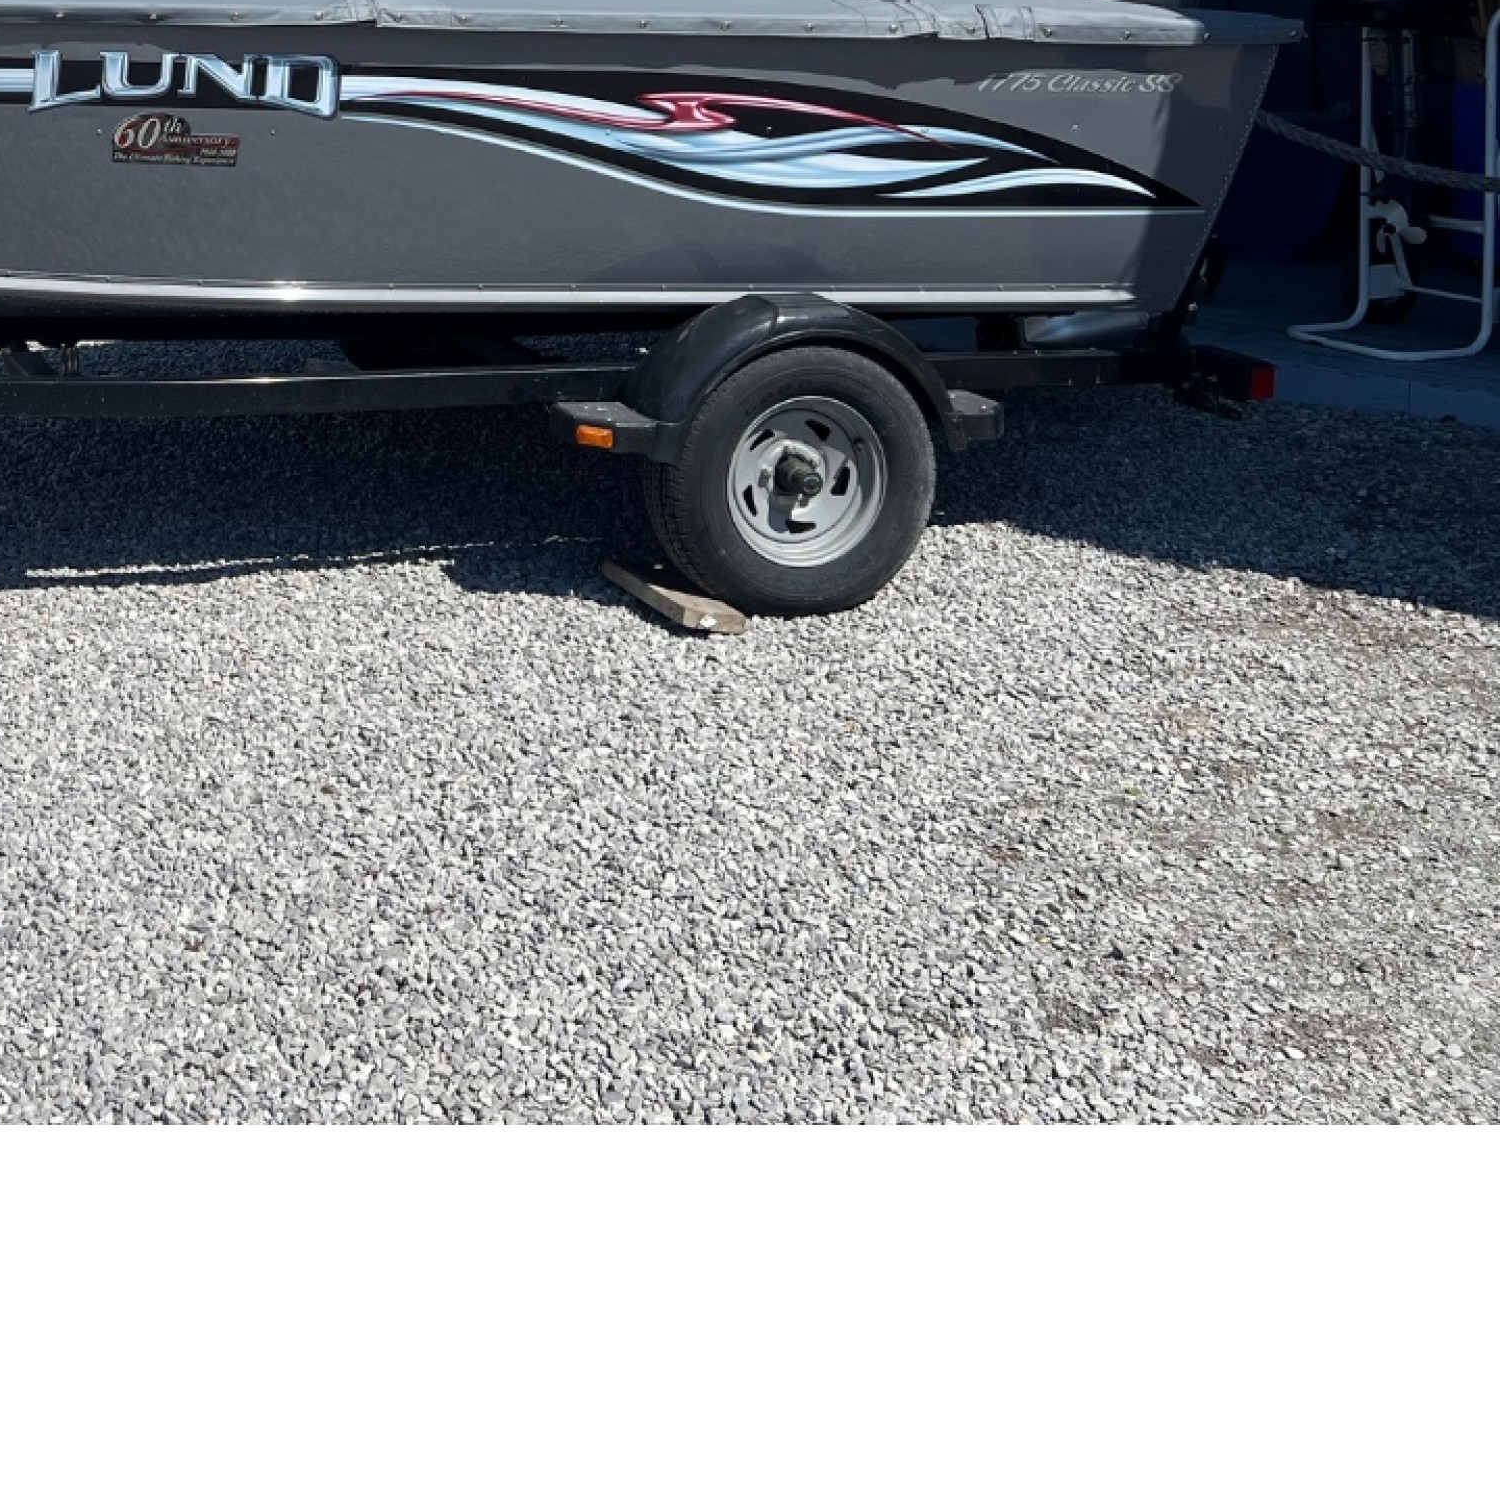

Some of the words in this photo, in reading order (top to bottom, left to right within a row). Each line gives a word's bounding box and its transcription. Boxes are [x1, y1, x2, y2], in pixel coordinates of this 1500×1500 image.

[28, 49, 339, 121] LUND
[977, 72, 1046, 92] 1775
[1047, 74, 1136, 93] Classic
